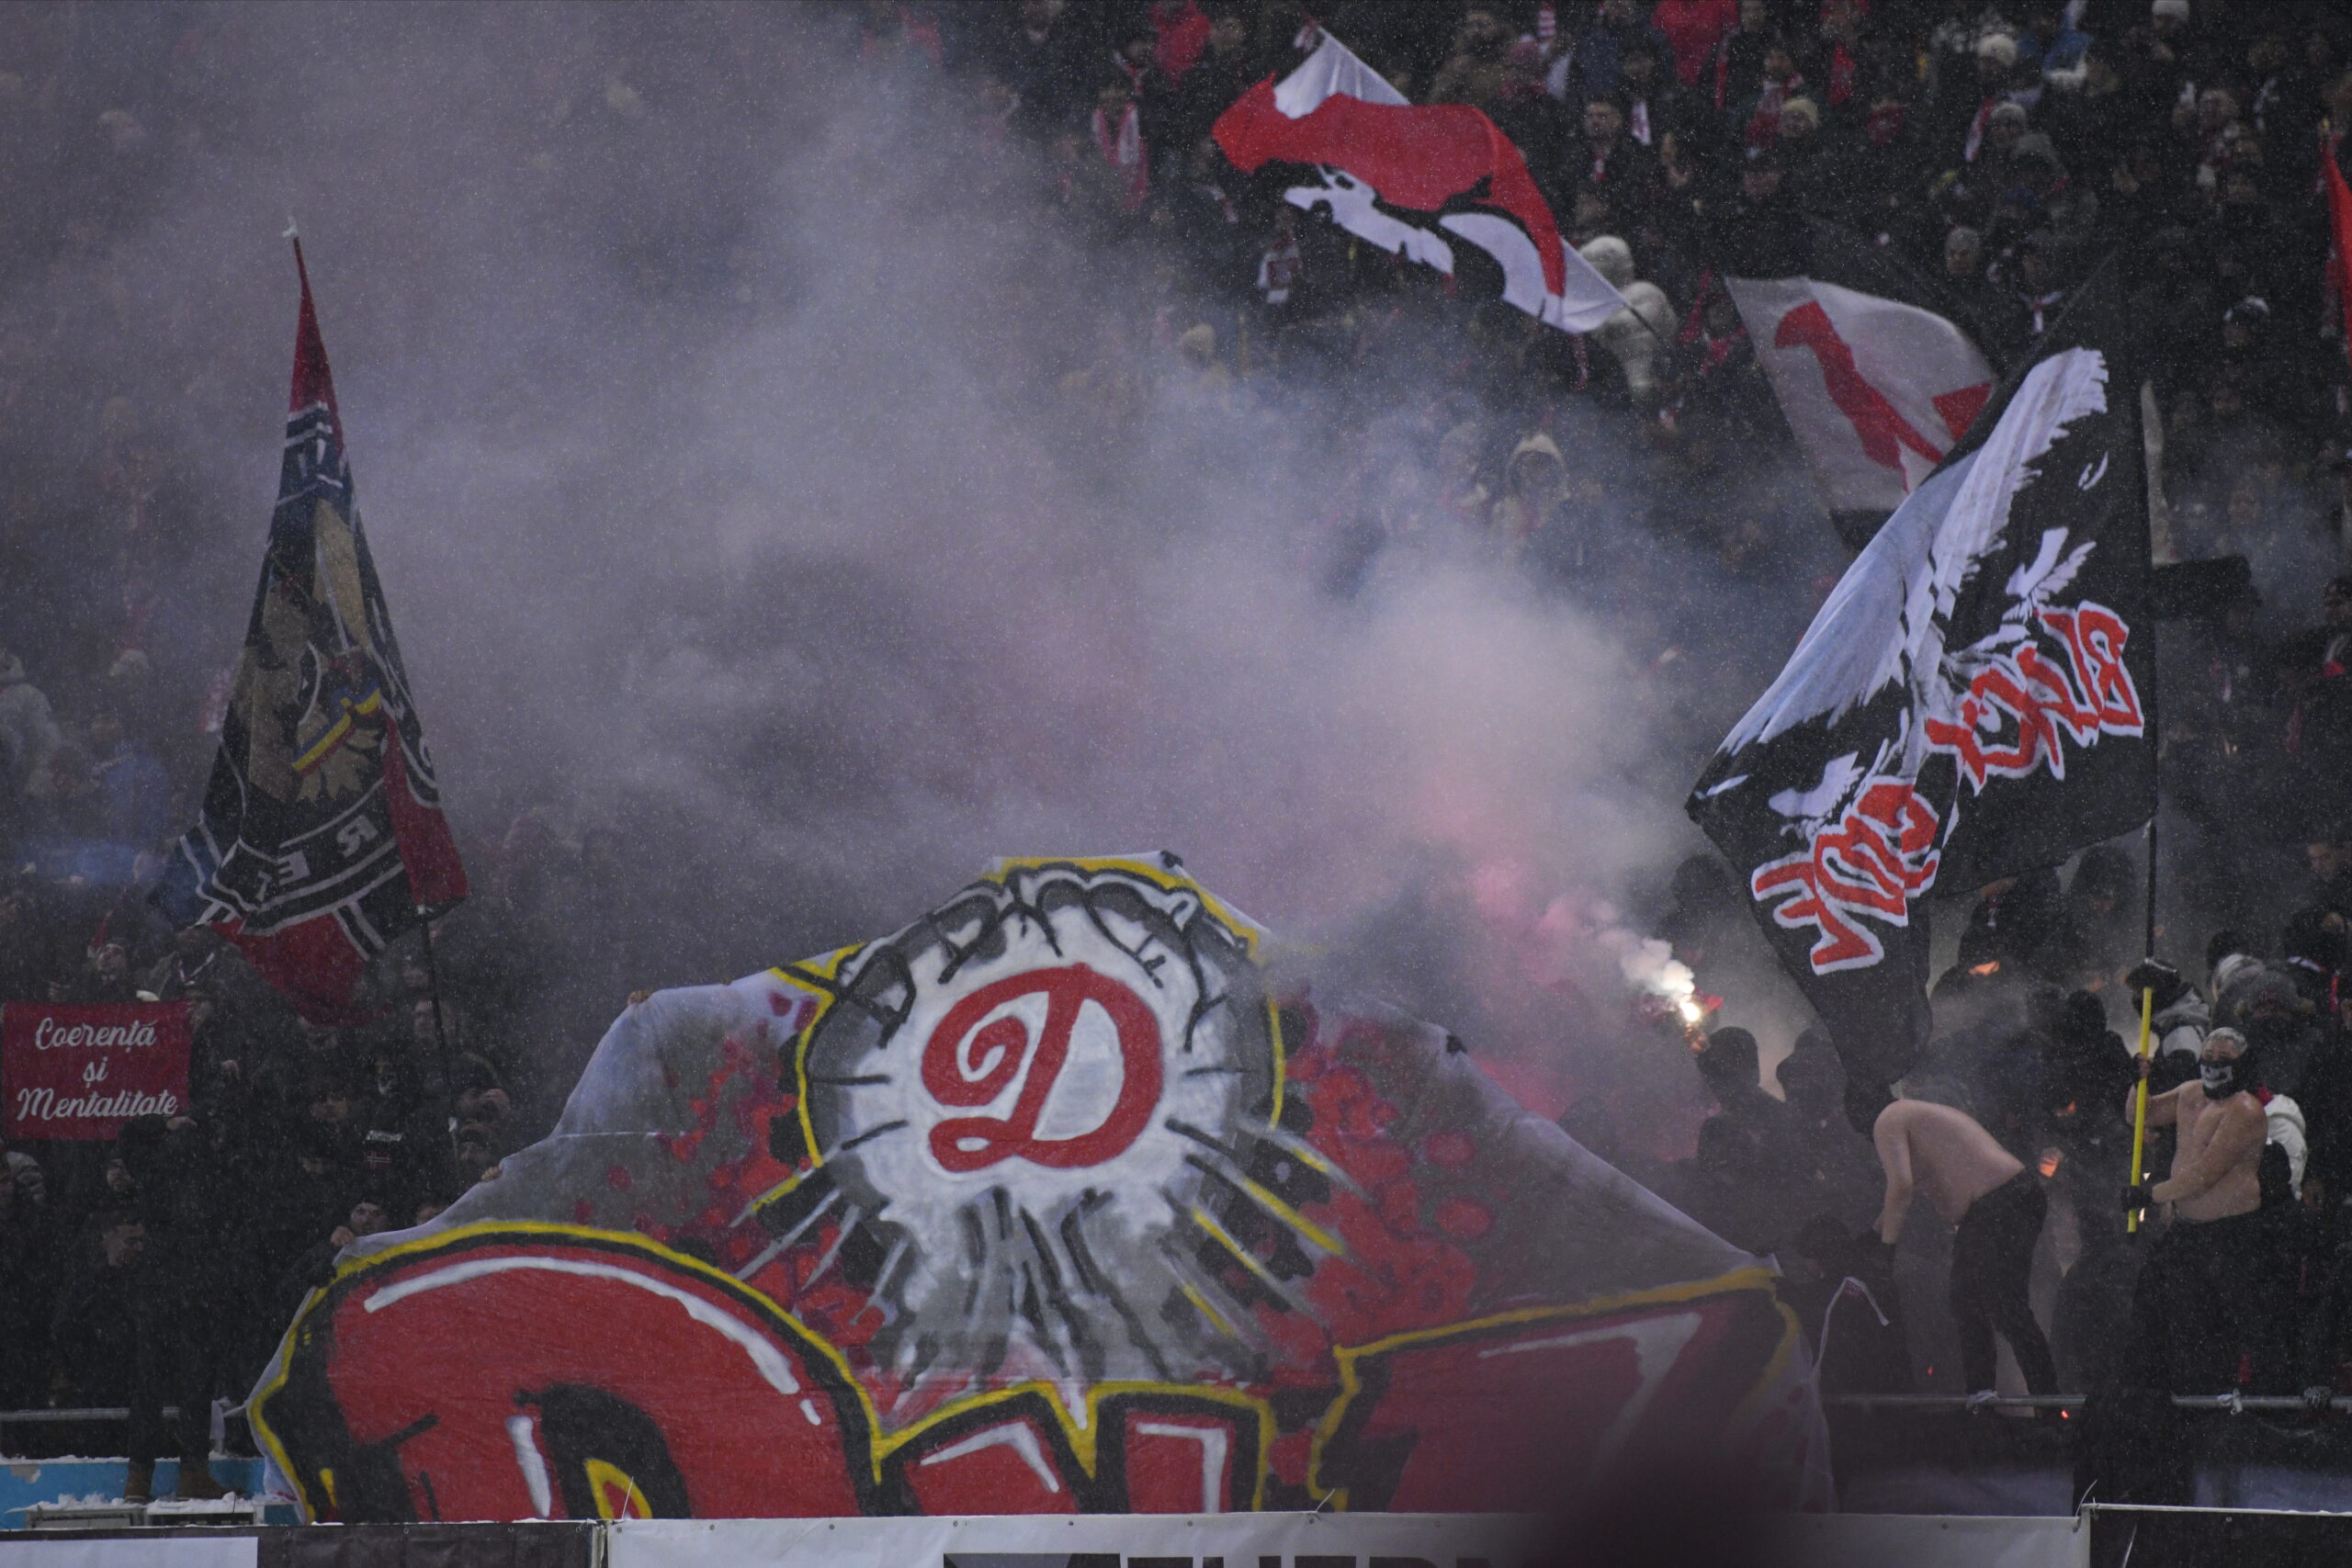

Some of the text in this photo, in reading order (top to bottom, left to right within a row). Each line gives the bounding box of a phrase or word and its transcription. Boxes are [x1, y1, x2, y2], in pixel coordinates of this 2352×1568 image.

[34, 1017, 159, 1053] Coerență
[82, 1056, 108, 1089] și
[921, 961, 1164, 1174] D
[16, 1088, 179, 1122] Mentalitate
